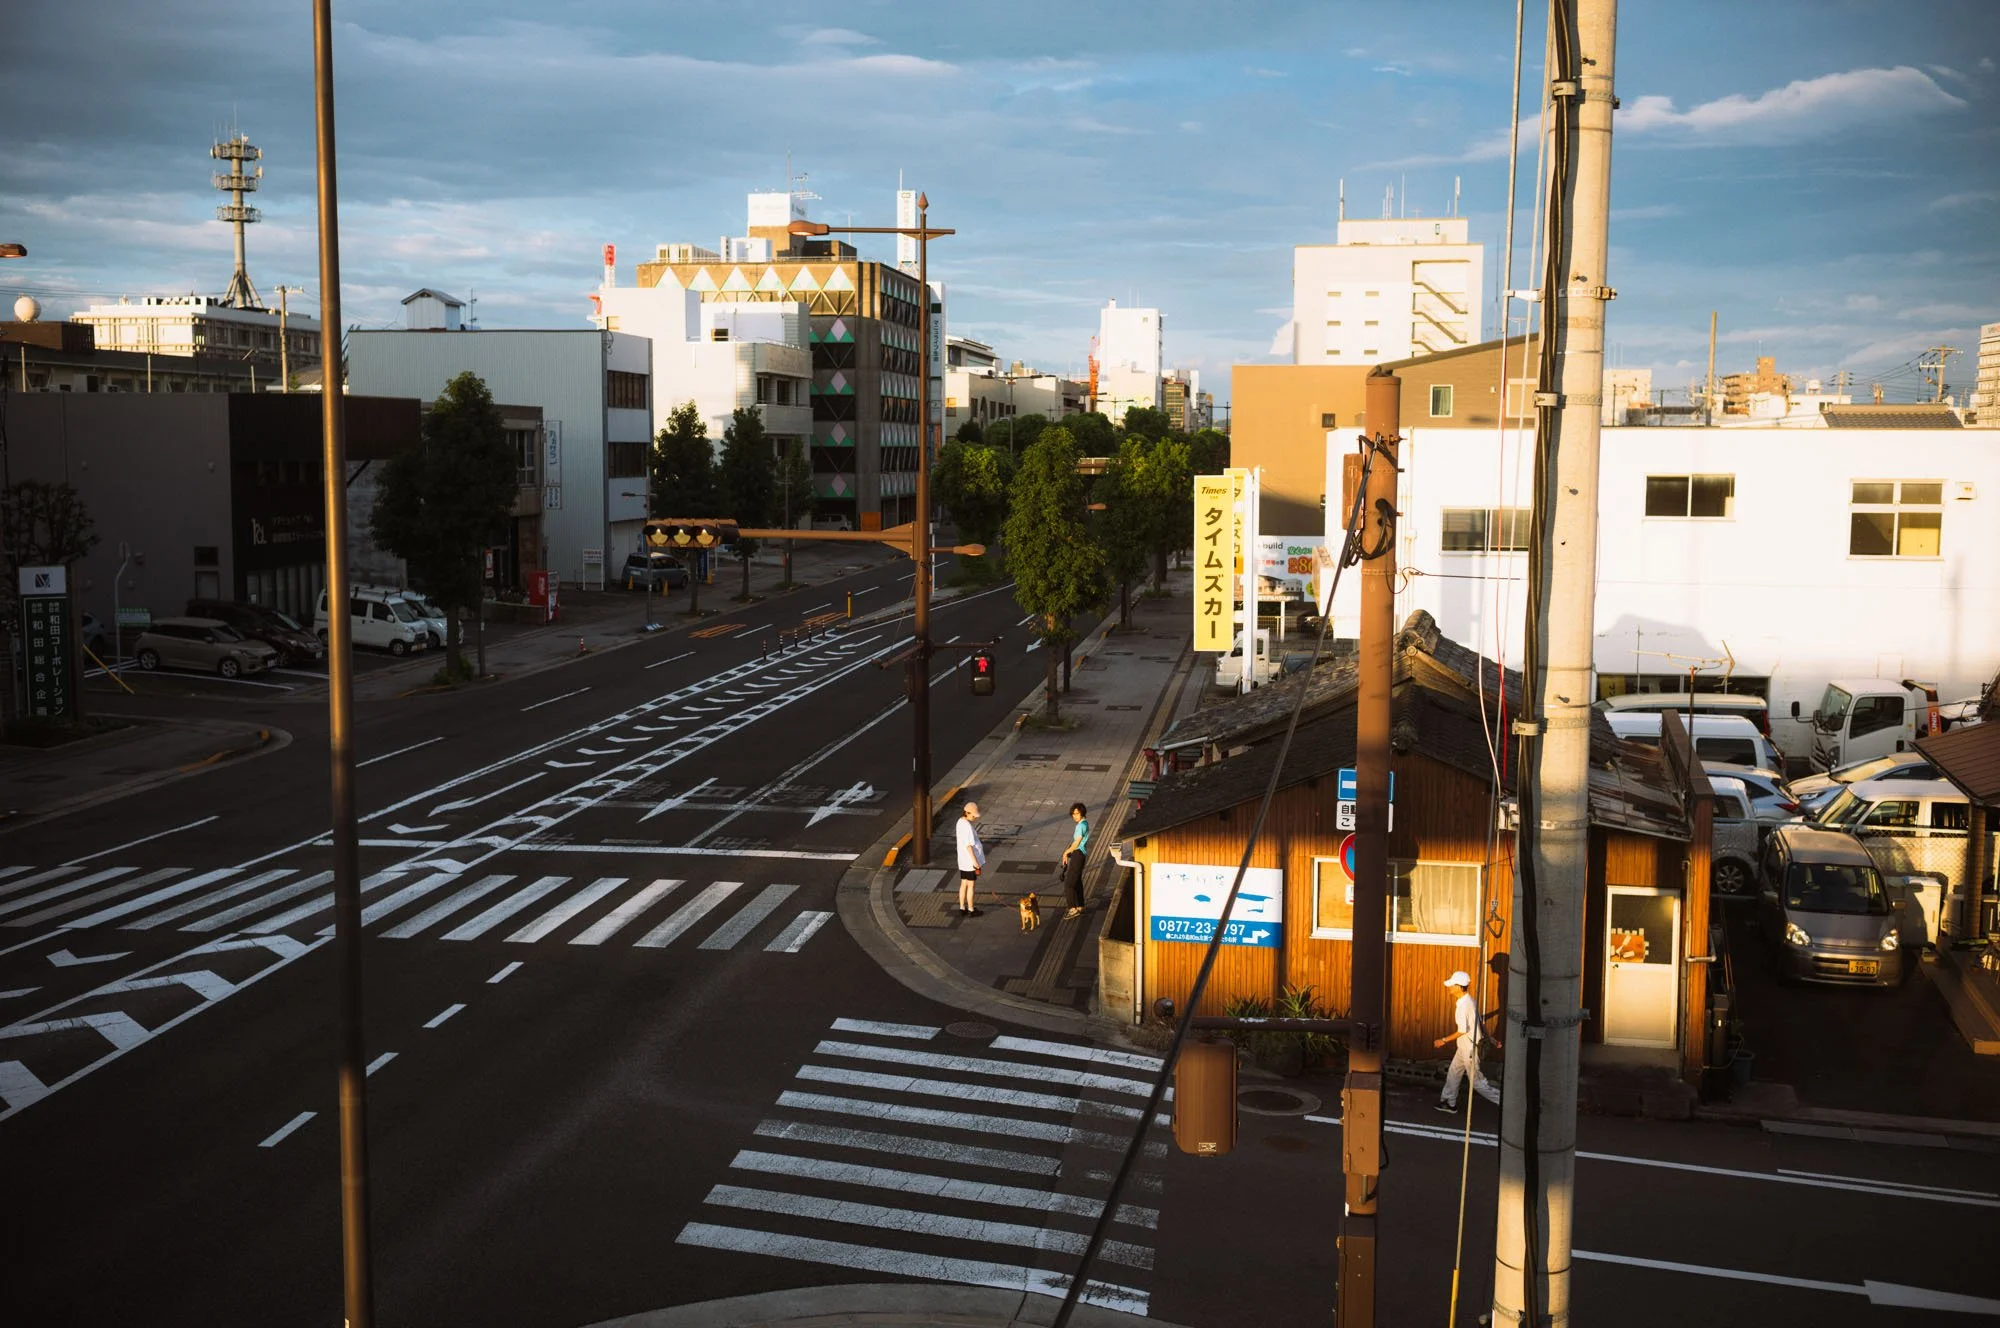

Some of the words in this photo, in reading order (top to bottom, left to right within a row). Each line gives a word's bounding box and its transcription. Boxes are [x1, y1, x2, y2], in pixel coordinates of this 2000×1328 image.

[1201, 486, 1228, 495] Times
[1204, 507, 1223, 639] タイムズカー
[49, 615, 64, 716] 和田コーポレーション
[1158, 920, 1245, 935] 0877-23-797
